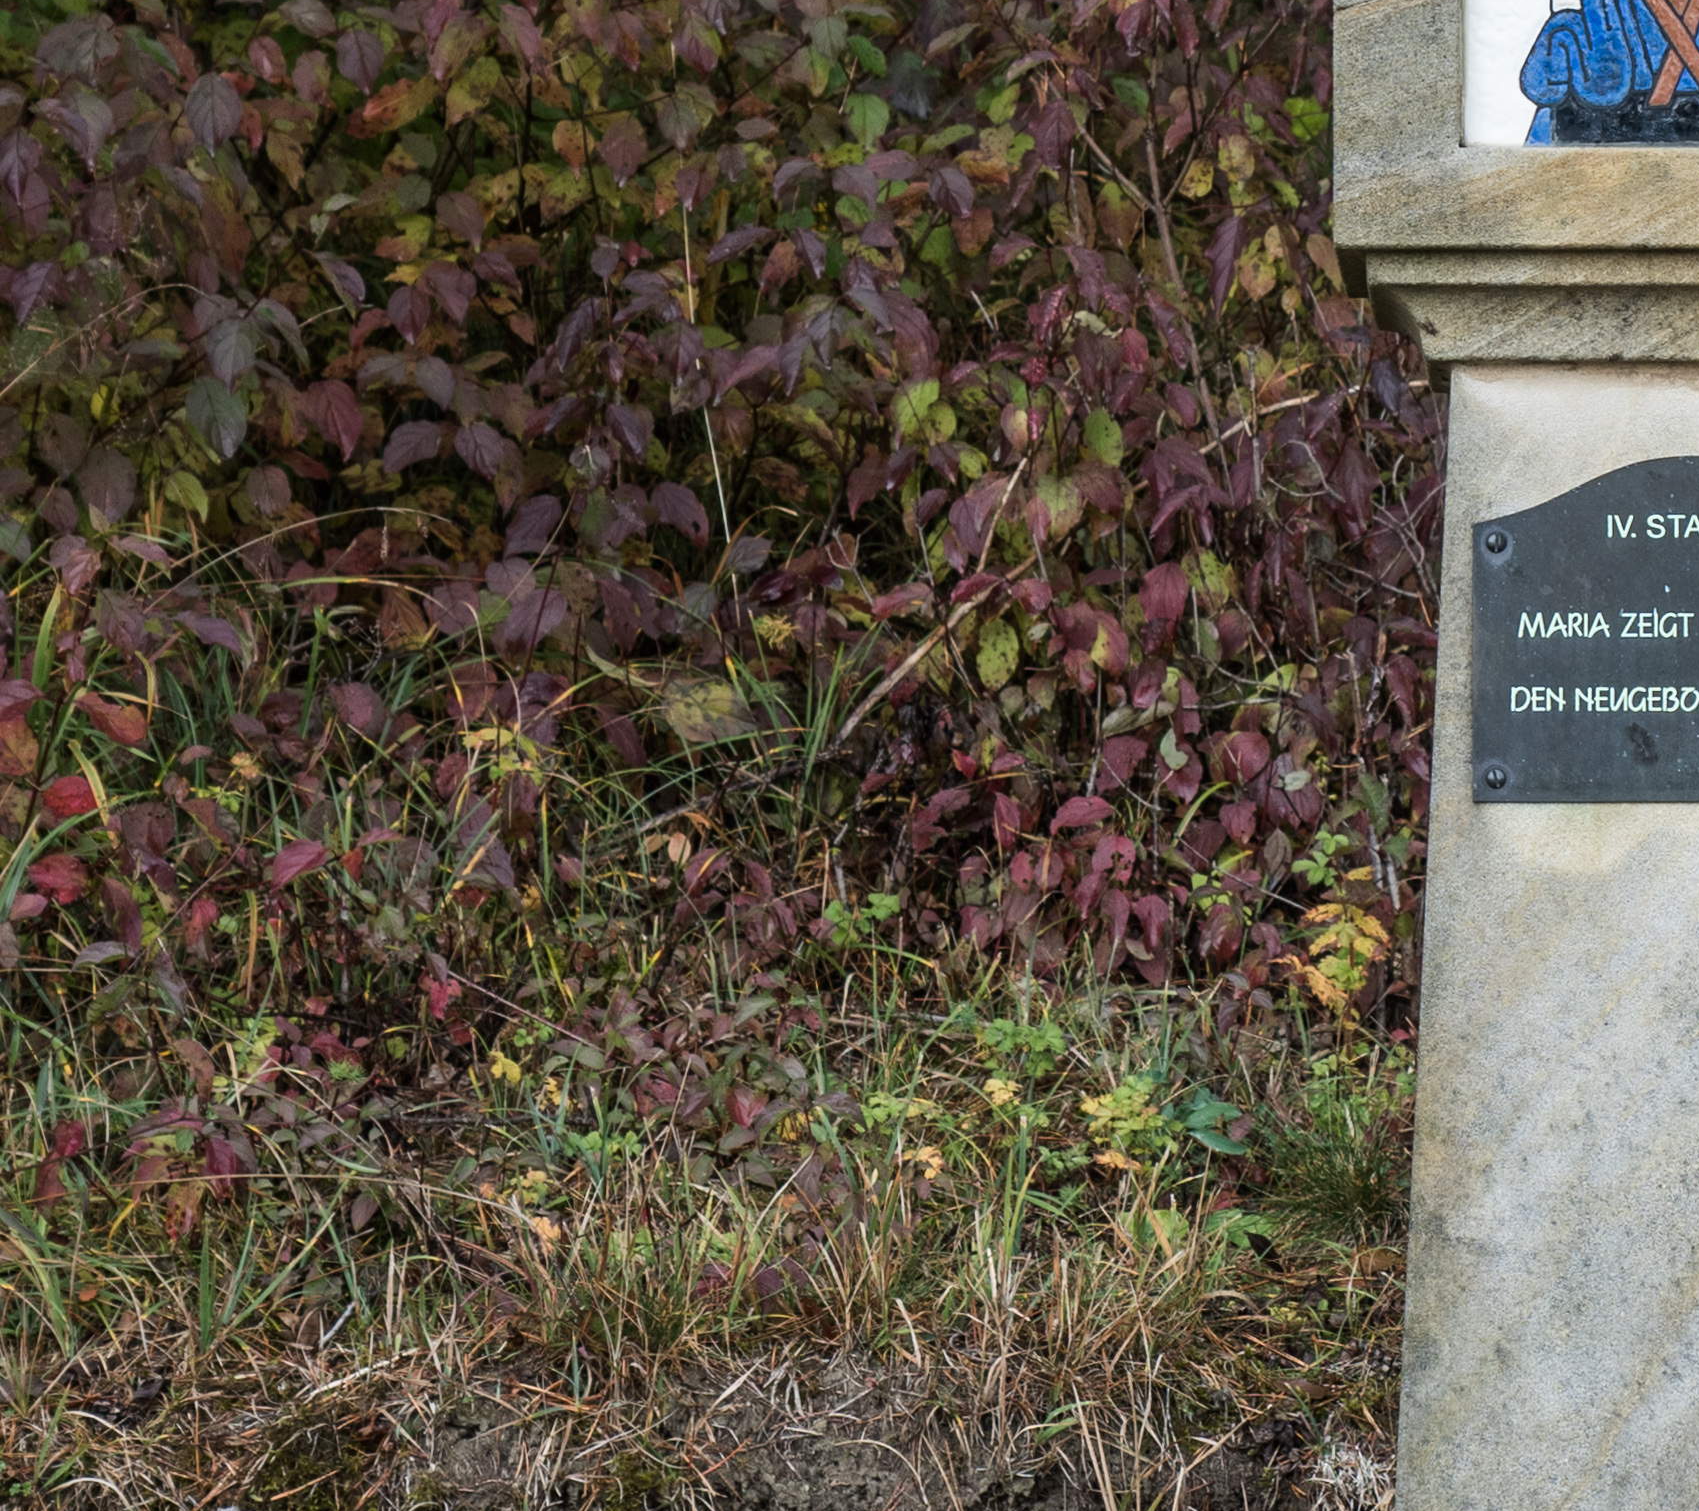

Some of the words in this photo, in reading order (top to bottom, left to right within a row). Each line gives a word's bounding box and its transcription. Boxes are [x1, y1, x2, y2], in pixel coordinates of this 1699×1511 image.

[1606, 514, 1638, 539] IV.
[1517, 611, 1611, 639] MARIA
[1620, 607, 1695, 639] ZEIGT
[1510, 685, 1567, 713] DEN
